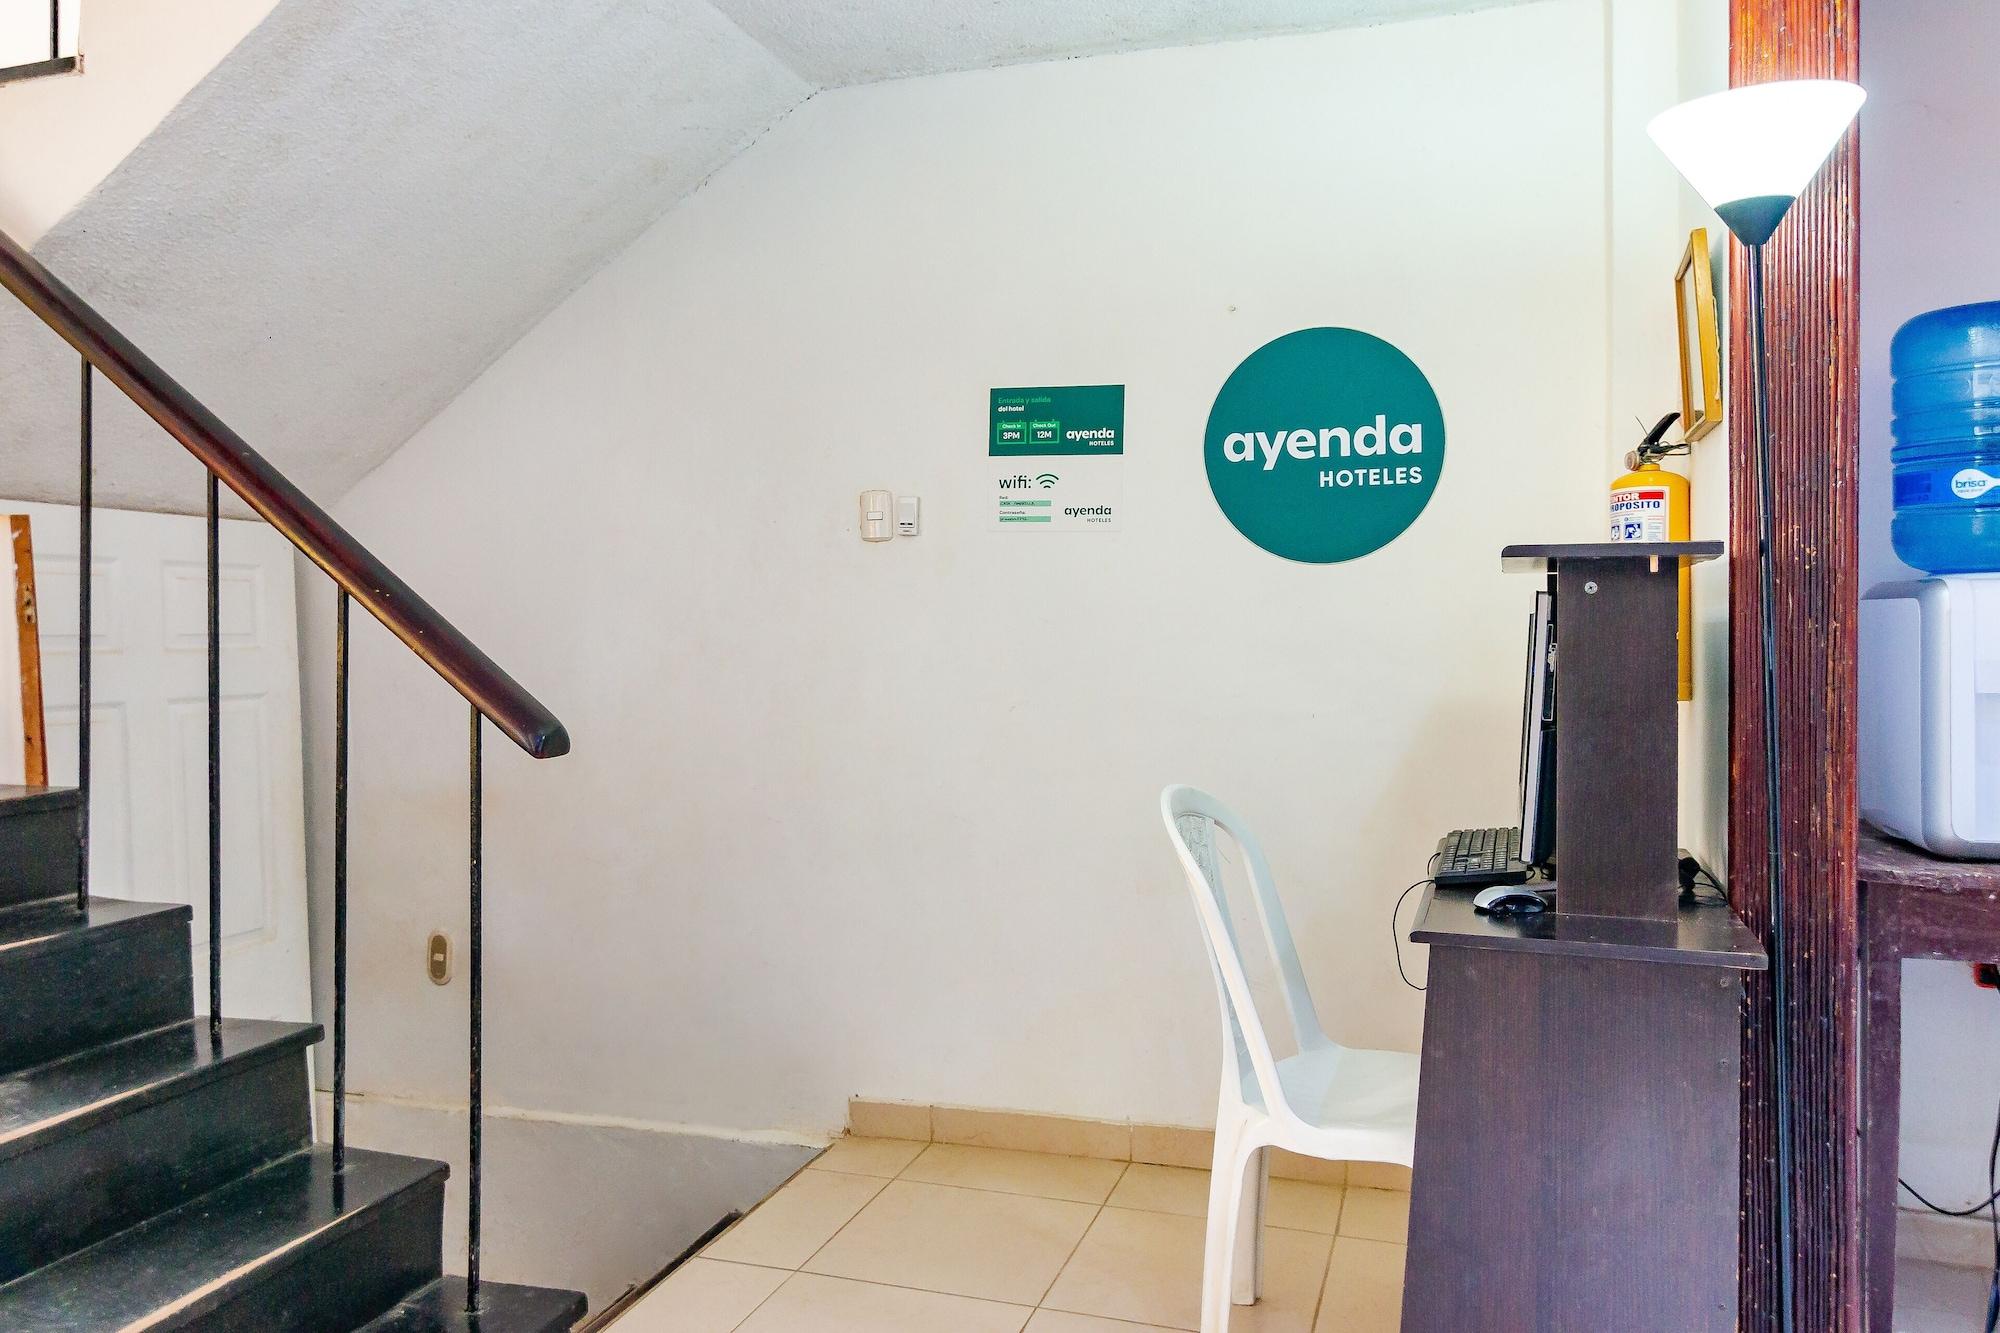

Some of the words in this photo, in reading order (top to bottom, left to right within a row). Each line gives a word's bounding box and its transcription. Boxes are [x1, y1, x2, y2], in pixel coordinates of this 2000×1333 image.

[1002, 432, 1020, 440] 3PM
[1036, 431, 1052, 439] 12M
[1066, 427, 1114, 441] ayenda
[1223, 414, 1422, 471] ayenda
[999, 475, 1032, 489] wifi:
[1319, 467, 1423, 488] HOTELES
[1955, 478, 1986, 489] brisa
[1064, 505, 1112, 517] ayenda
